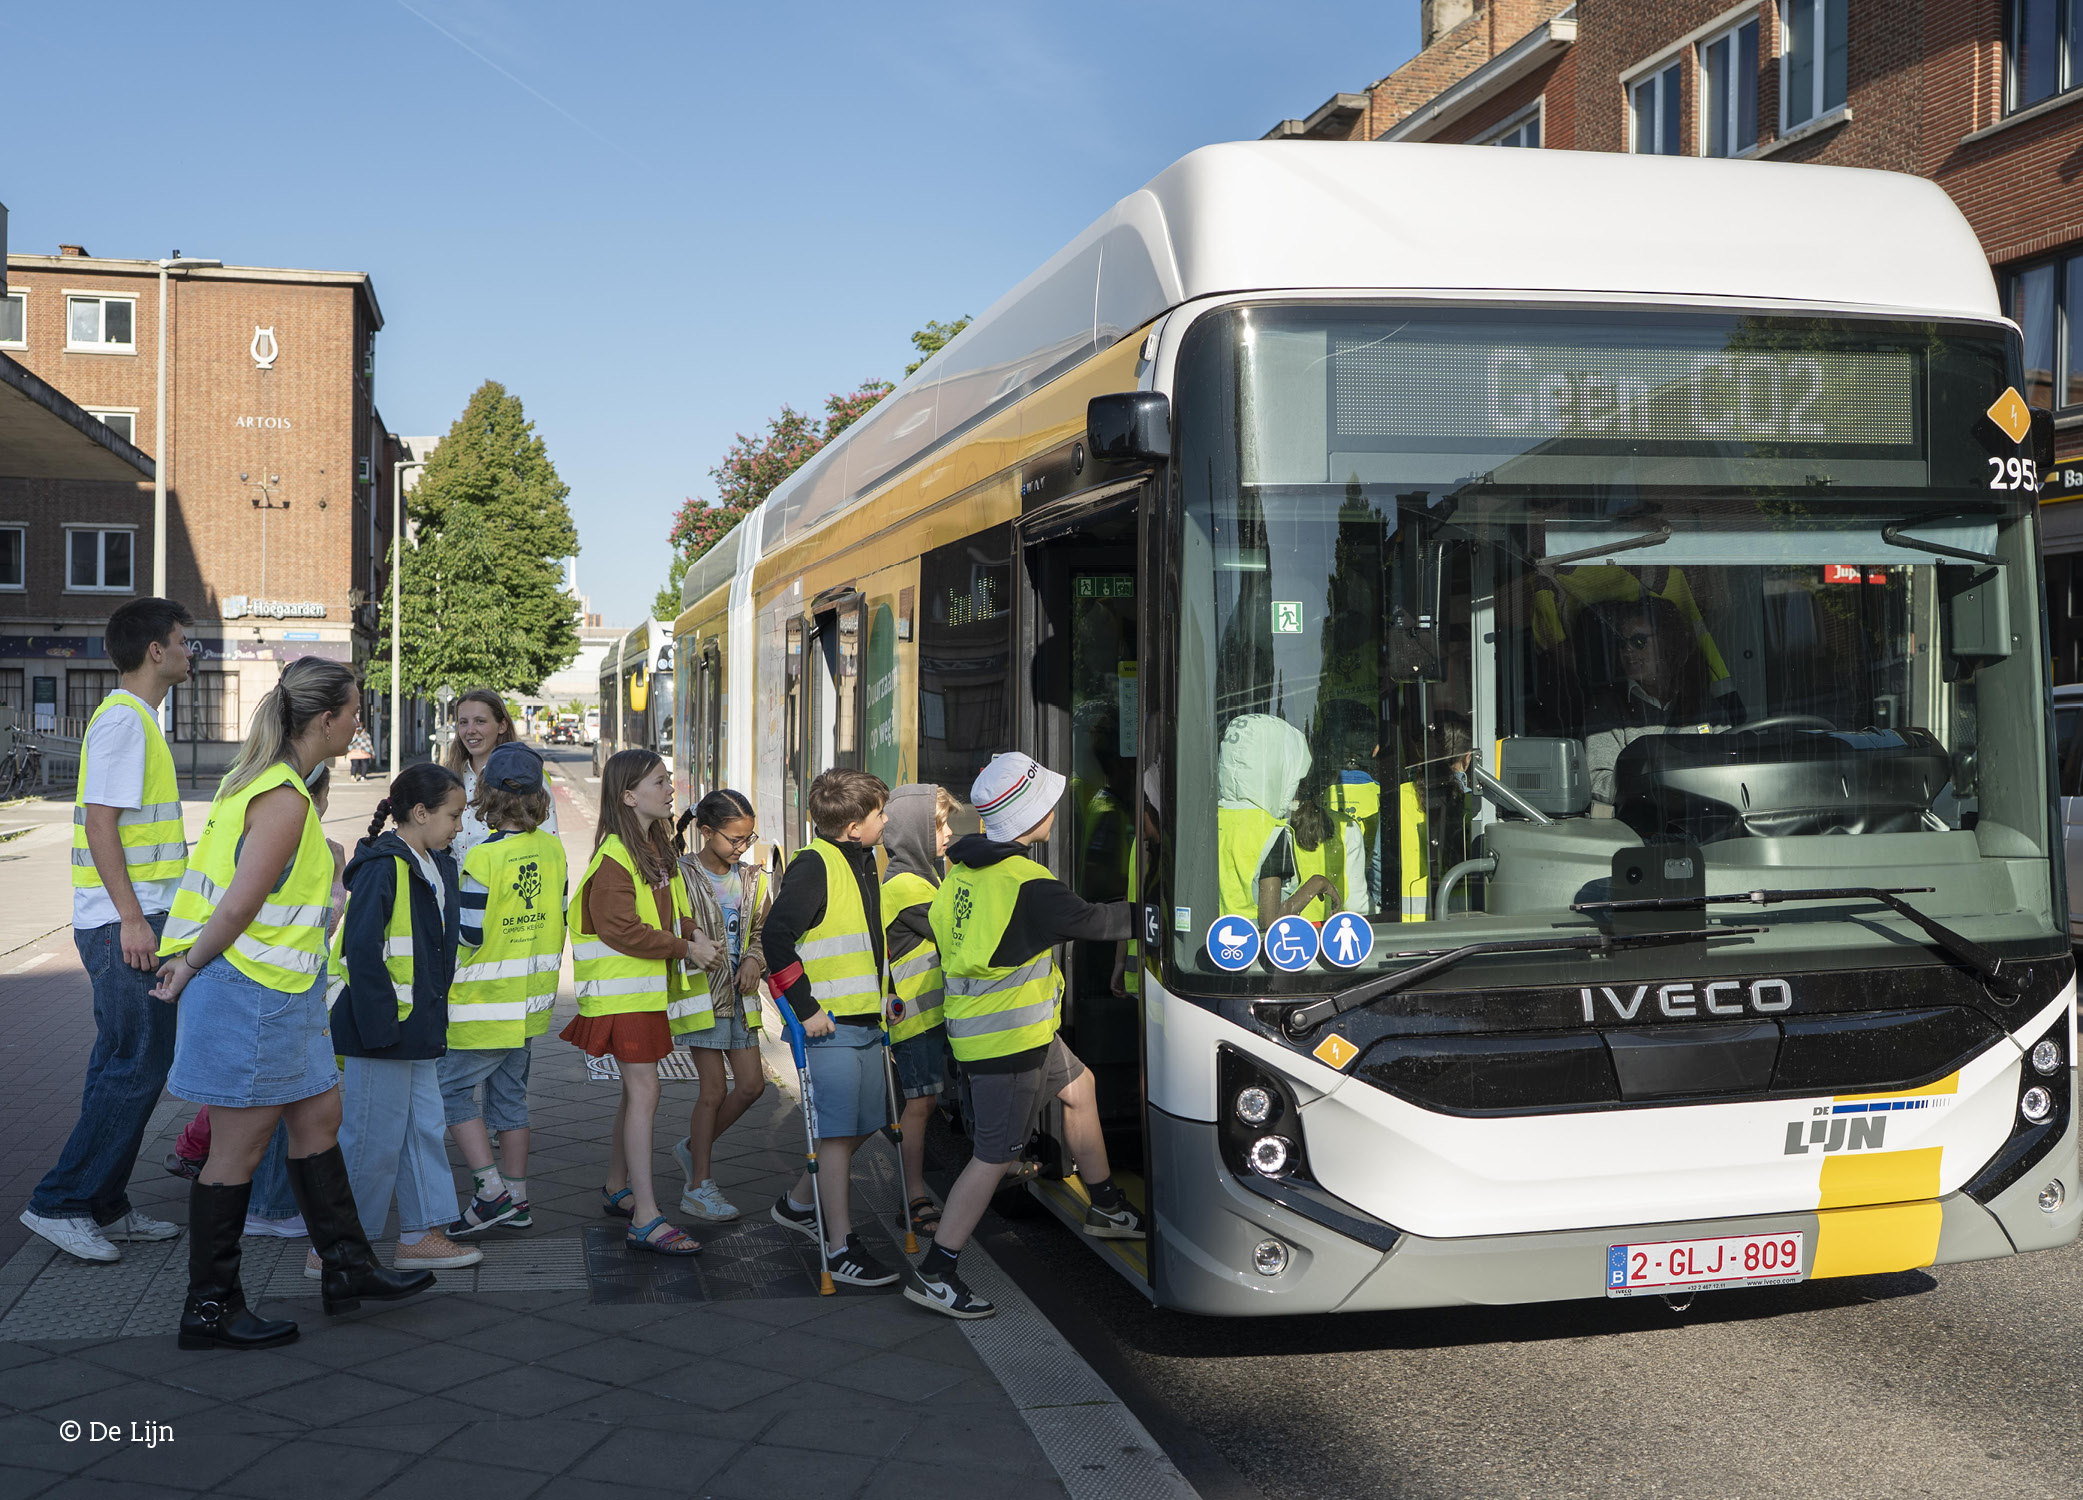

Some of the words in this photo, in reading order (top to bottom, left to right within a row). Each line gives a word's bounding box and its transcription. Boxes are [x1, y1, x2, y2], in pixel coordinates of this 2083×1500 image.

[1488, 349, 1649, 431] Geen
[1691, 354, 1824, 435] CO2
[235, 415, 292, 429] ARTOIS
[251, 600, 326, 619] Hoegaarden
[866, 666, 898, 710] Duurzaam
[870, 727, 879, 757] op
[503, 917, 515, 926] DE
[1581, 978, 1792, 1022] IVECO
[1812, 1106, 1830, 1116] DE
[1612, 1270, 1624, 1284] B
[1747, 1277, 1796, 1287] www.iveco.com
